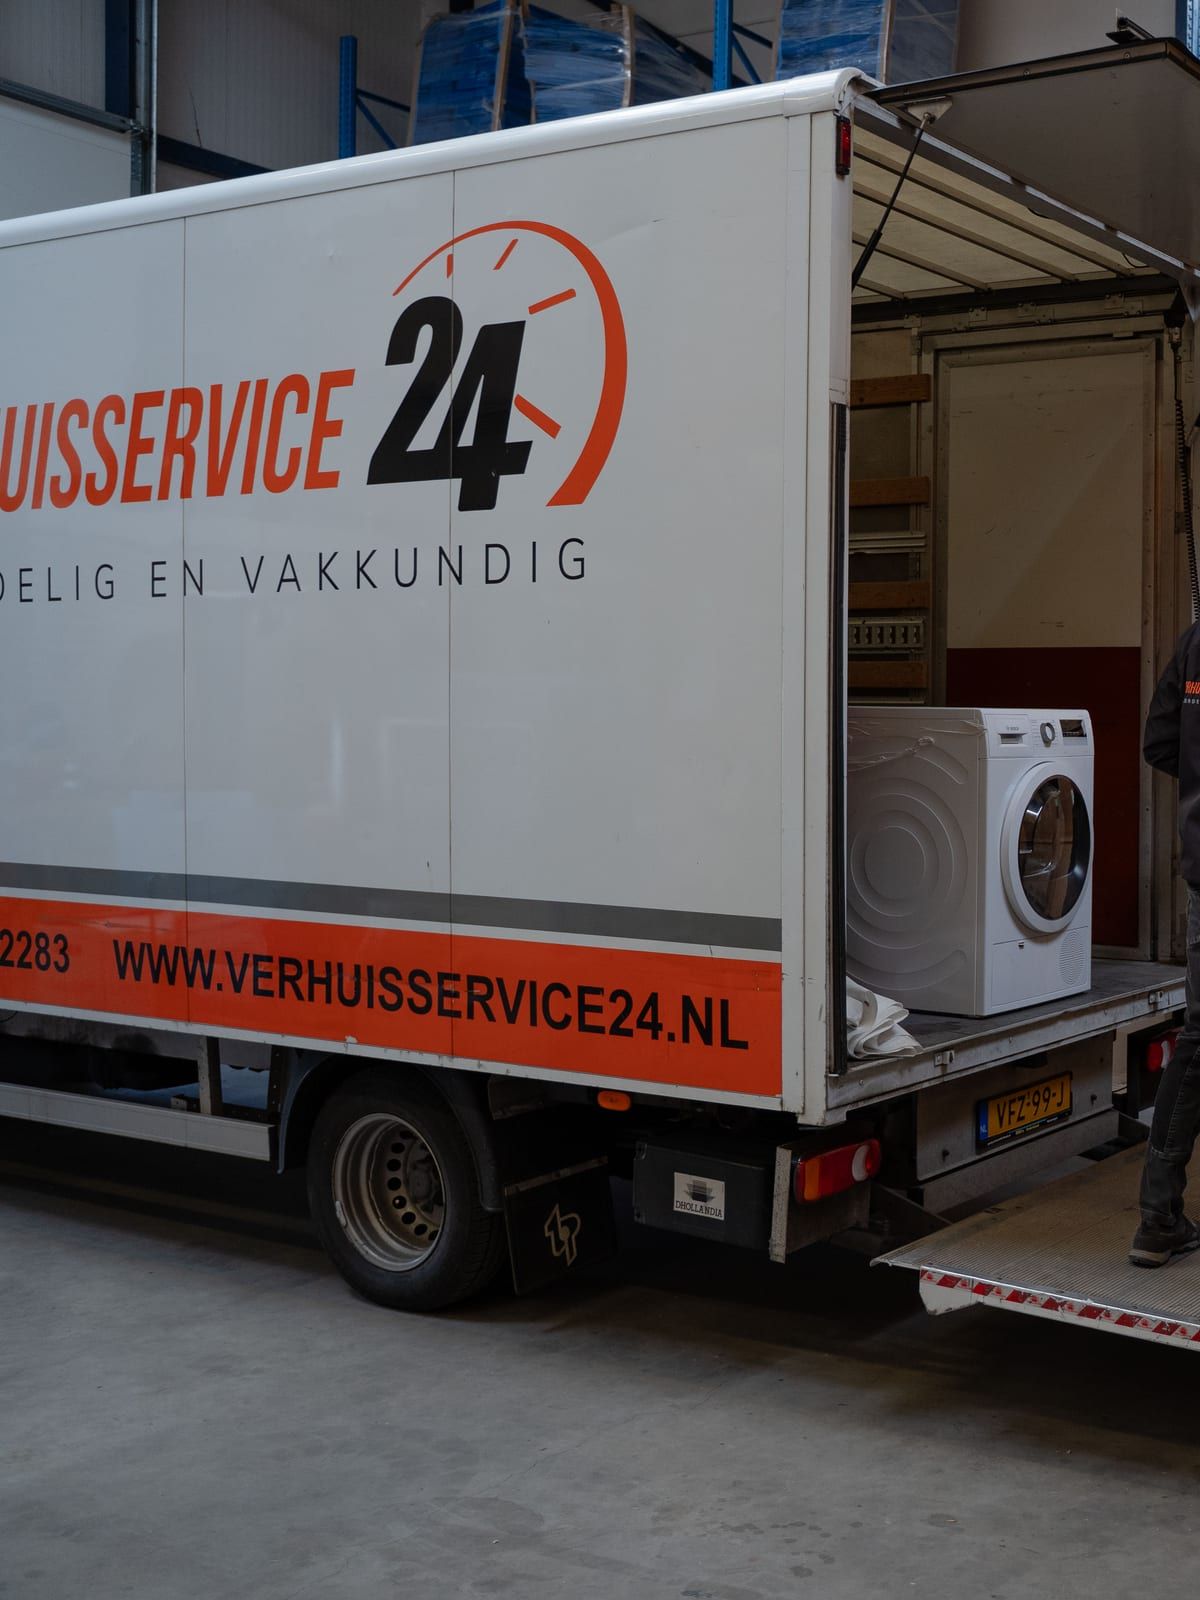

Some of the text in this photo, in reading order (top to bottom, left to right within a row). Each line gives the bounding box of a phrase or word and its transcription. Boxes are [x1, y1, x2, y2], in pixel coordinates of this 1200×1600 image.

[0, 295, 533, 512] UISSERVICE 24
[0, 536, 587, 603] ELIG EN VAKKUNDIG
[0, 928, 749, 1050] 2283 WWW.VERHUISSERVICE24.NL
[675, 1200, 723, 1218] DHOLLANDIA
